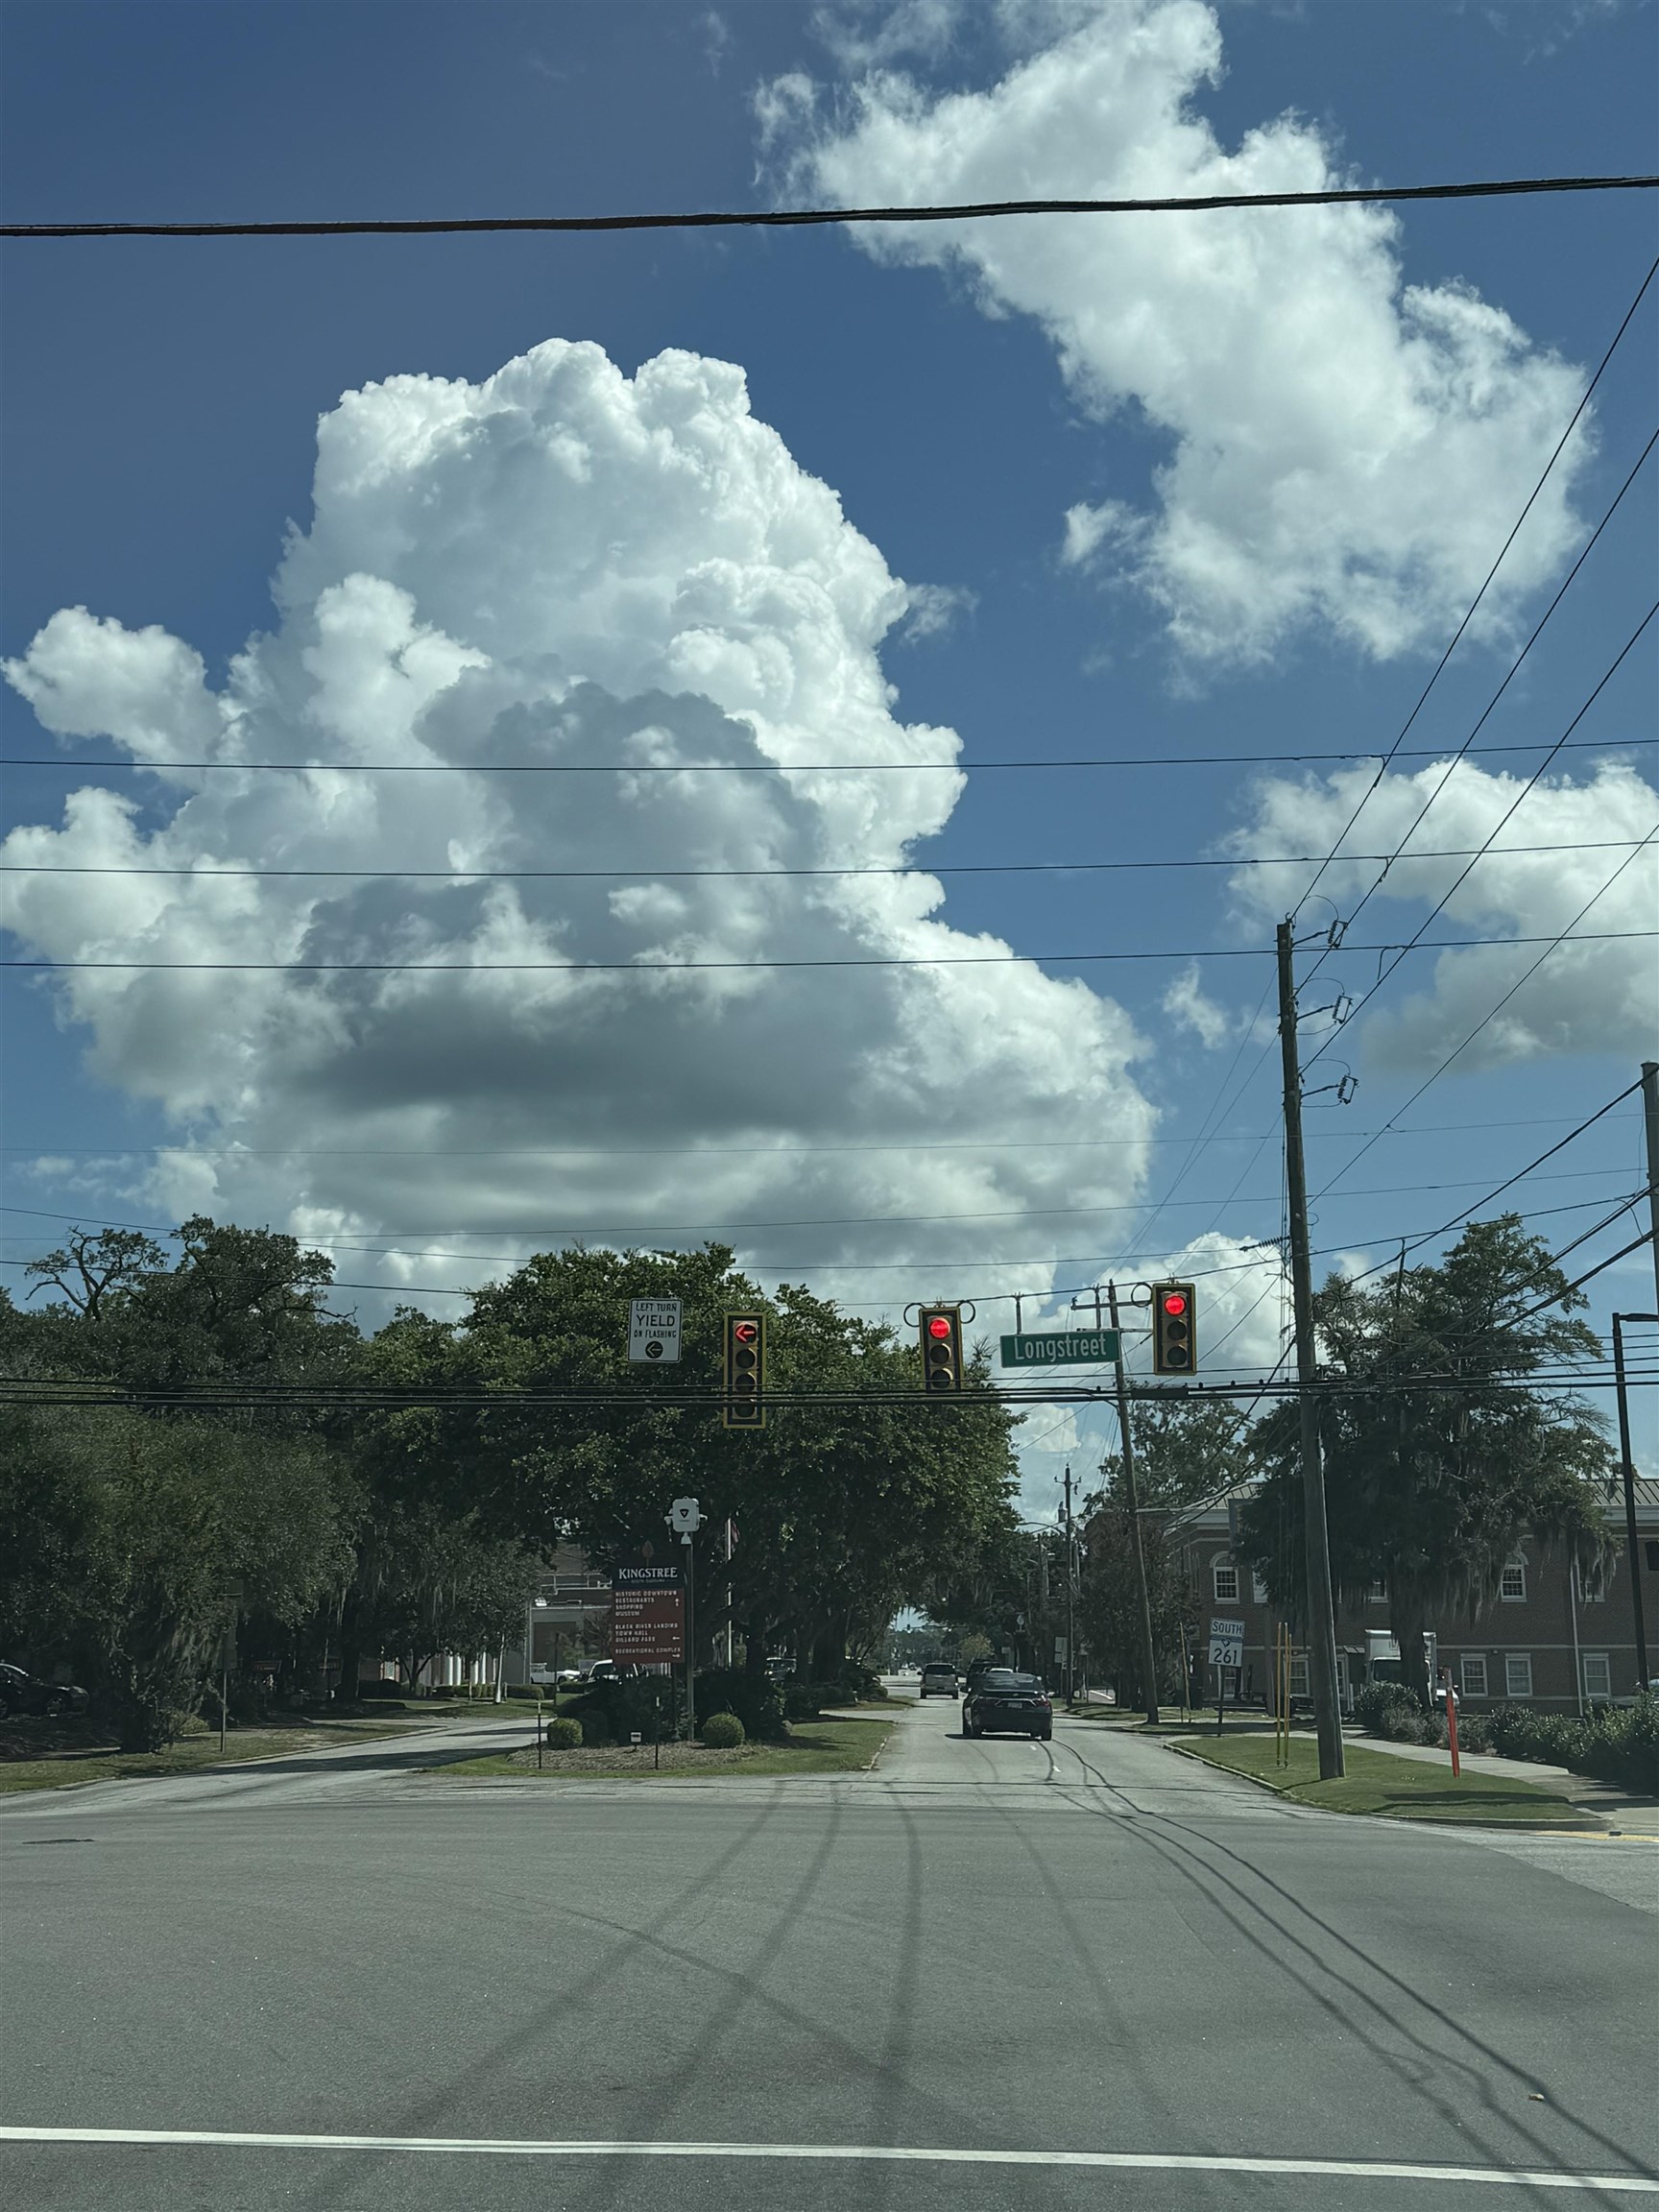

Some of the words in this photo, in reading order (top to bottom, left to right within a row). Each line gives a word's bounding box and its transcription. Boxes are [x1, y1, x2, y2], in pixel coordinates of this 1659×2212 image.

[636, 1302, 654, 1311] LEFT
[657, 1302, 677, 1311] TURN
[636, 1314, 676, 1327] YIELD
[634, 1329, 643, 1338] ON
[644, 1329, 677, 1338] FLASHING
[1014, 1333, 1107, 1362] Longstreet
[618, 1567, 678, 1579] KINGSTREE
[1212, 1621, 1242, 1635] SOUTH
[1214, 1647, 1238, 1665] 261
